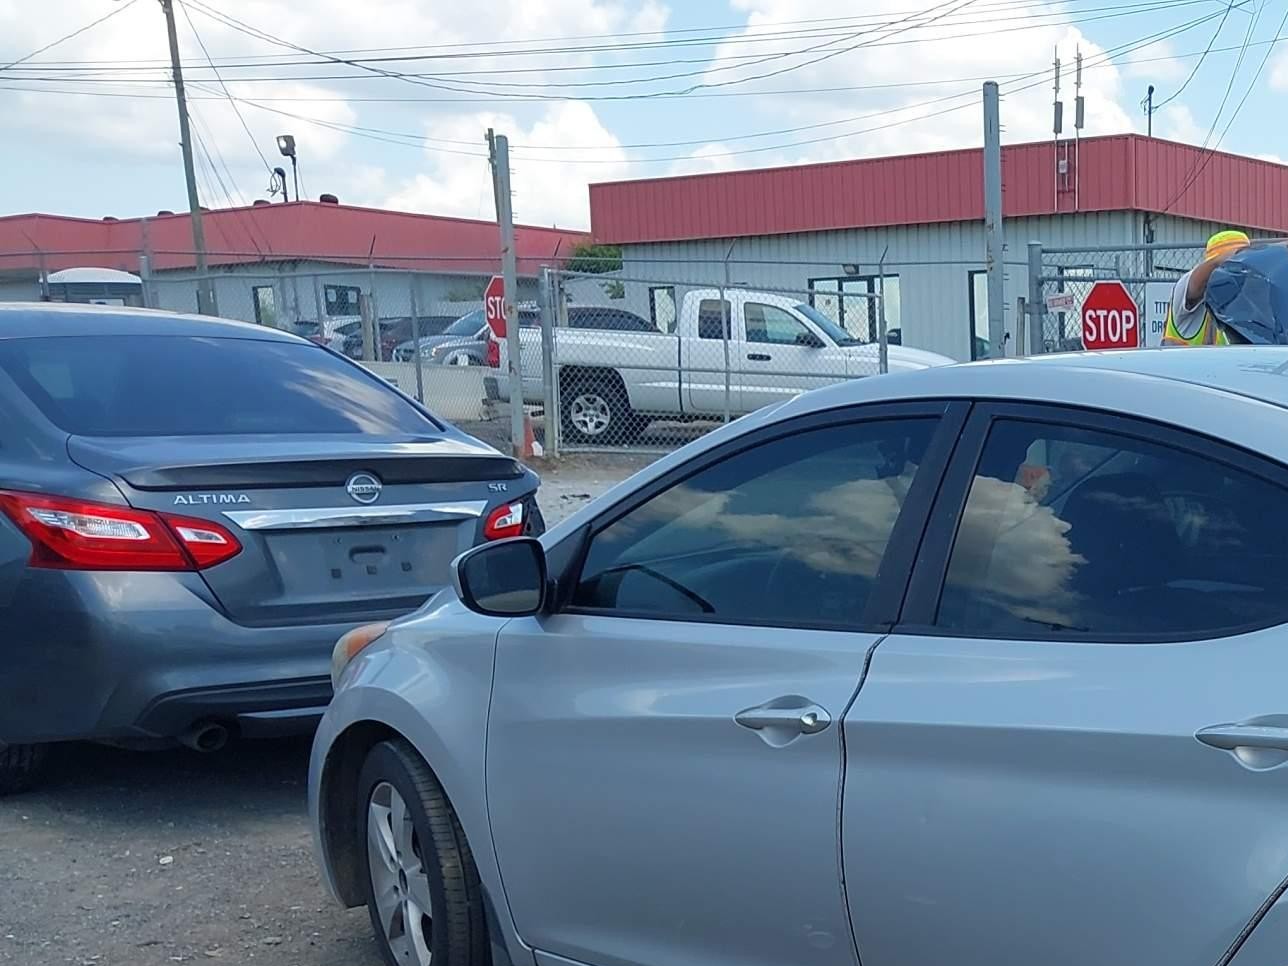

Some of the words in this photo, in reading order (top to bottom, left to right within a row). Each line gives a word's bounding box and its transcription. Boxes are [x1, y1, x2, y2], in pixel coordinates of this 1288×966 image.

[488, 296, 507, 319] STO
[1085, 309, 1135, 342] STOP
[488, 483, 507, 491] SR
[174, 494, 251, 504] ALTIMA
